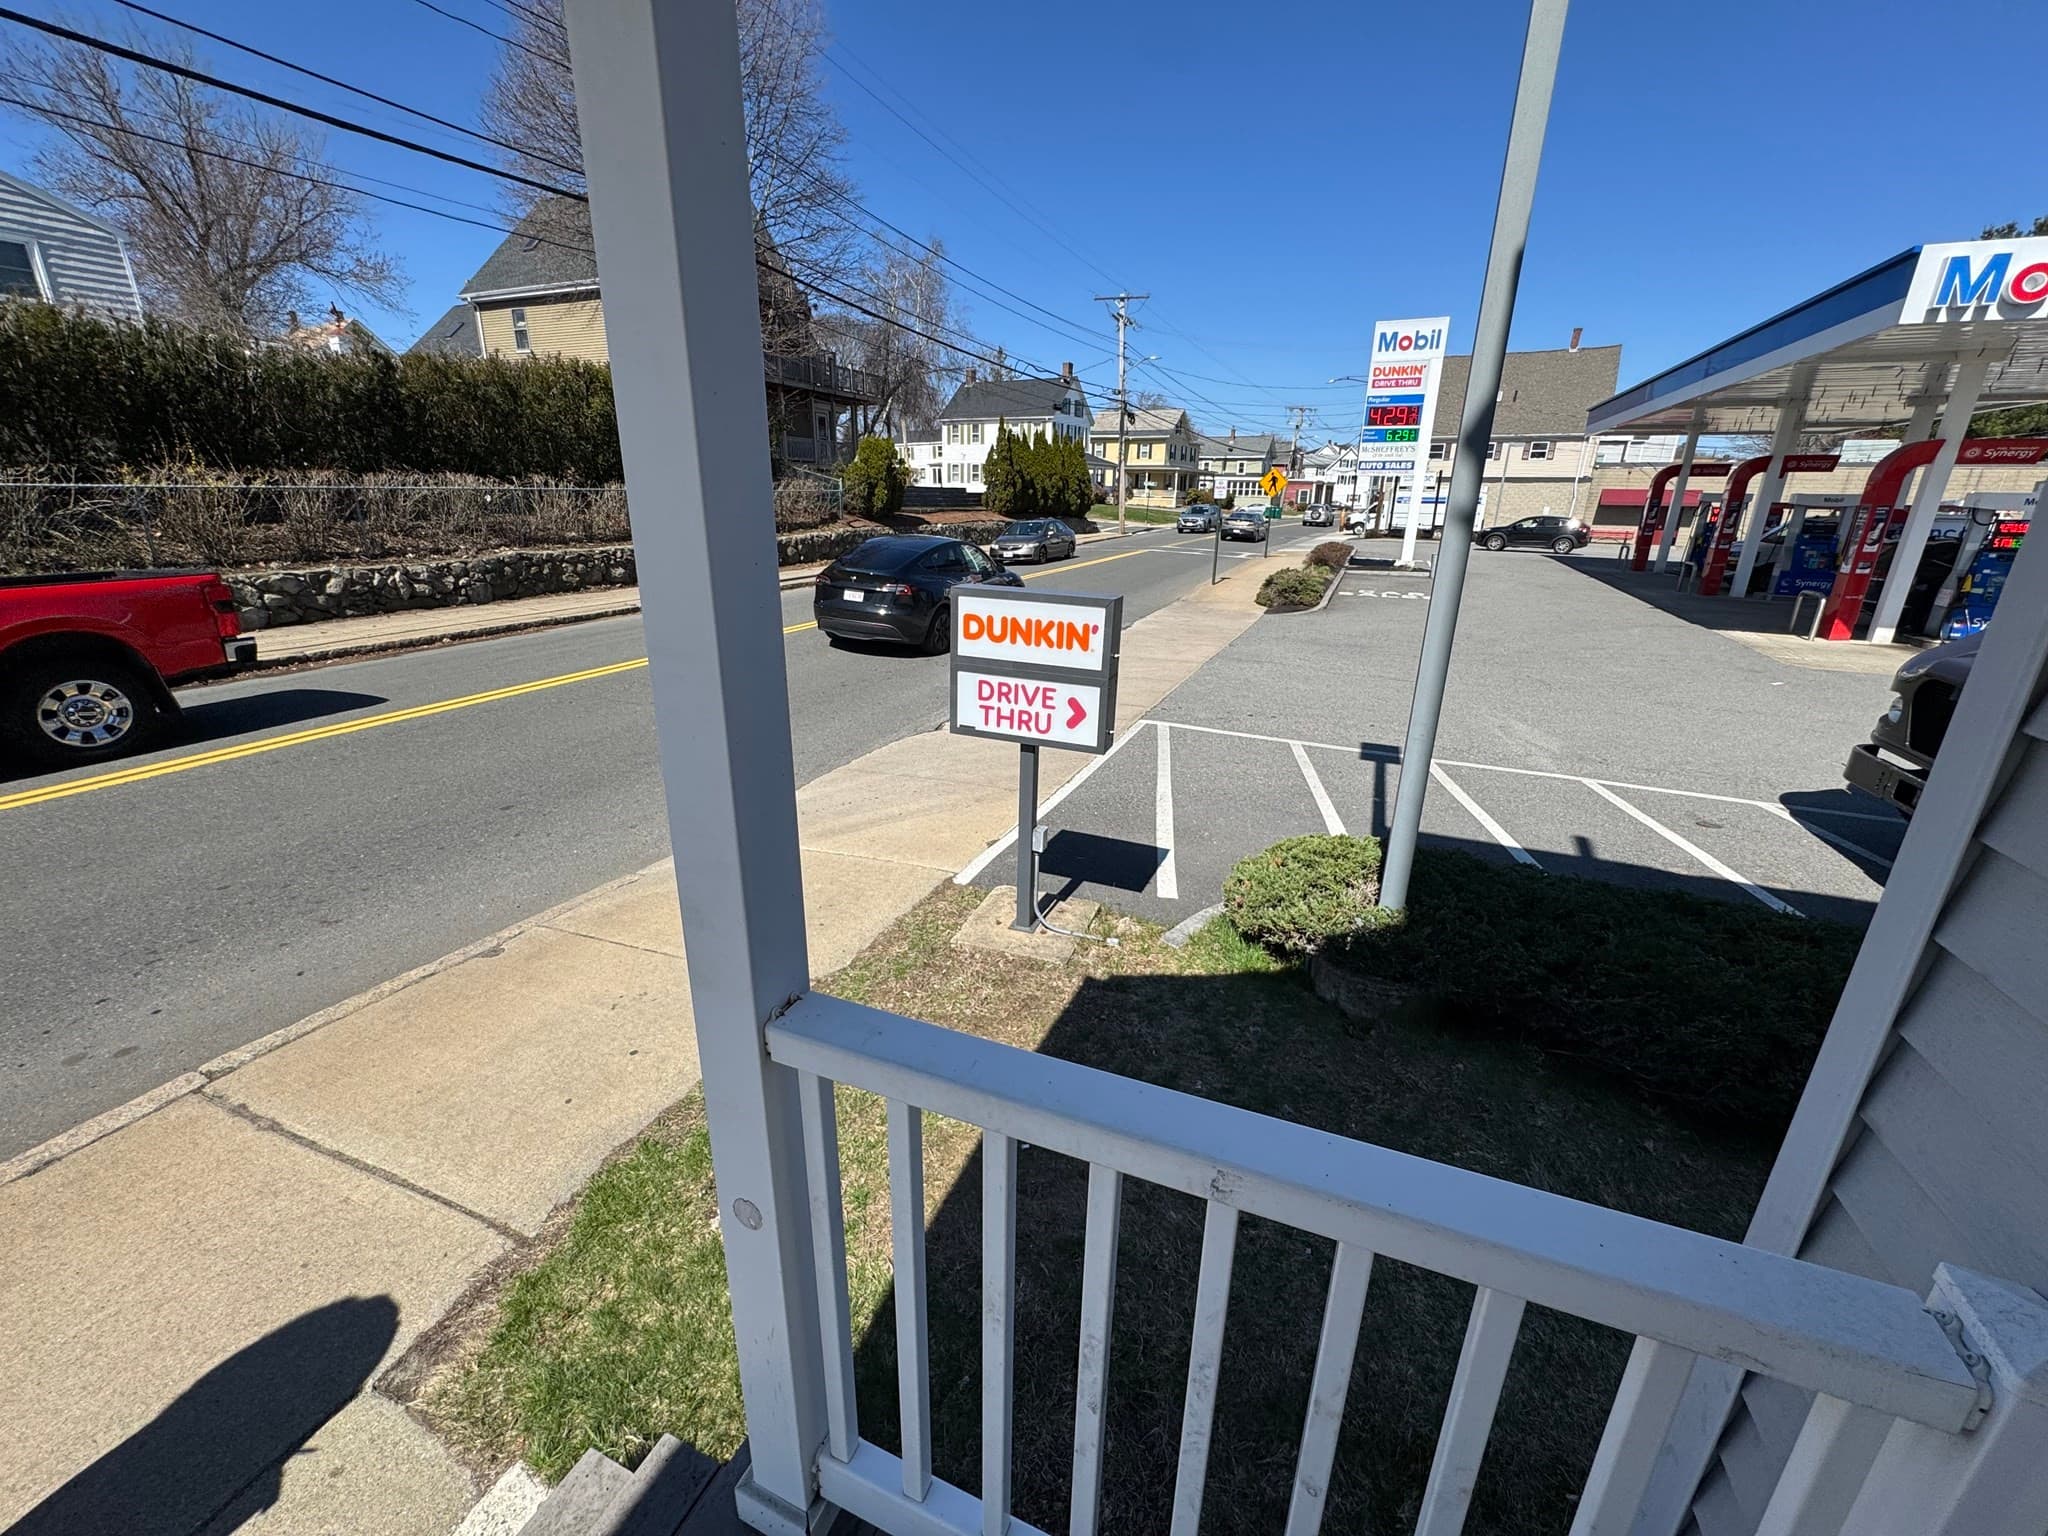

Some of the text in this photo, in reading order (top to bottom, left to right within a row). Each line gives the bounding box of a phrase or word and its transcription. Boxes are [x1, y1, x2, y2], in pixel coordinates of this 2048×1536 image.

[1378, 328, 1442, 352] Mobil
[1373, 365, 1427, 377] DUNKIN'
[1374, 380, 1397, 388] DRIVE
[1984, 448, 2037, 459] Synergy
[1385, 461, 1413, 469] SALES
[1794, 578, 1833, 589] Synergy
[962, 613, 1098, 652] DUNKIN'
[977, 679, 1057, 710] DRIVE
[978, 704, 1052, 735] THRU
